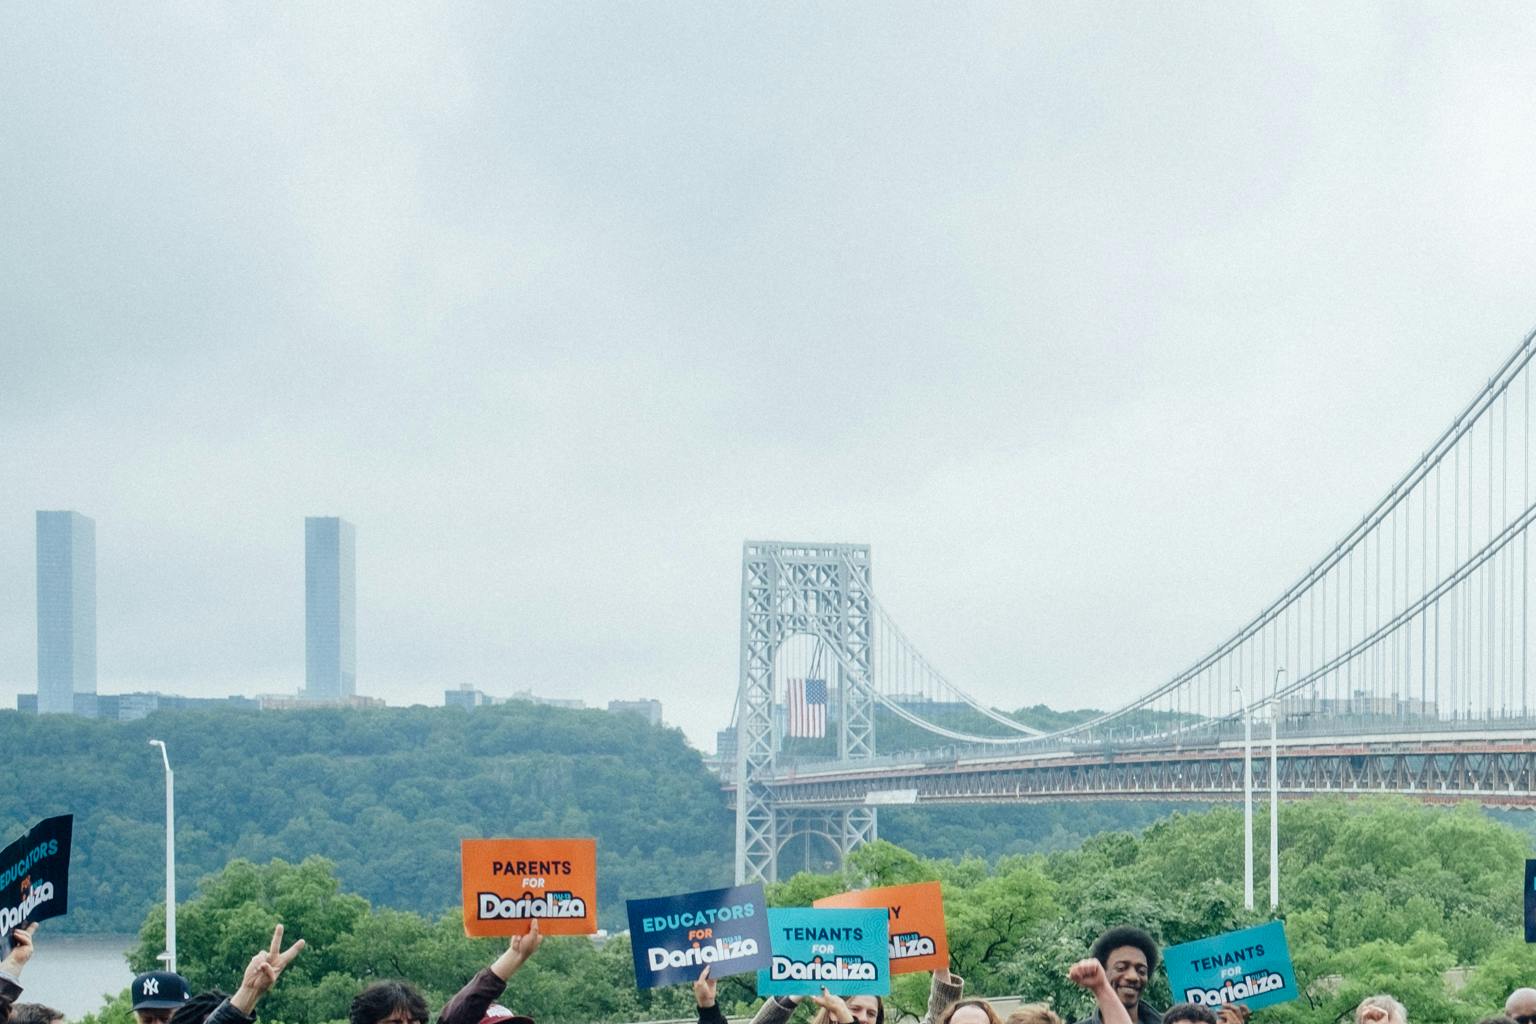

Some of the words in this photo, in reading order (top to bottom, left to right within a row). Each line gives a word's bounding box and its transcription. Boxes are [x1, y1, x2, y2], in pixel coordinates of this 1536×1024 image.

[0, 839, 58, 891] EDUCATORS
[492, 861, 572, 876] PARENTS
[522, 878, 546, 889] FOR
[479, 892, 586, 919] Darializa
[642, 902, 755, 933] EDUCATORS
[688, 928, 713, 941] FOR
[783, 927, 863, 941] TENANTS
[648, 937, 759, 972] Darializa
[812, 944, 835, 954] FOR
[1191, 944, 1265, 972] TENANTS
[771, 956, 876, 981] Darializa
[1221, 966, 1242, 979] FOR
[1186, 973, 1284, 1006] Darializa
